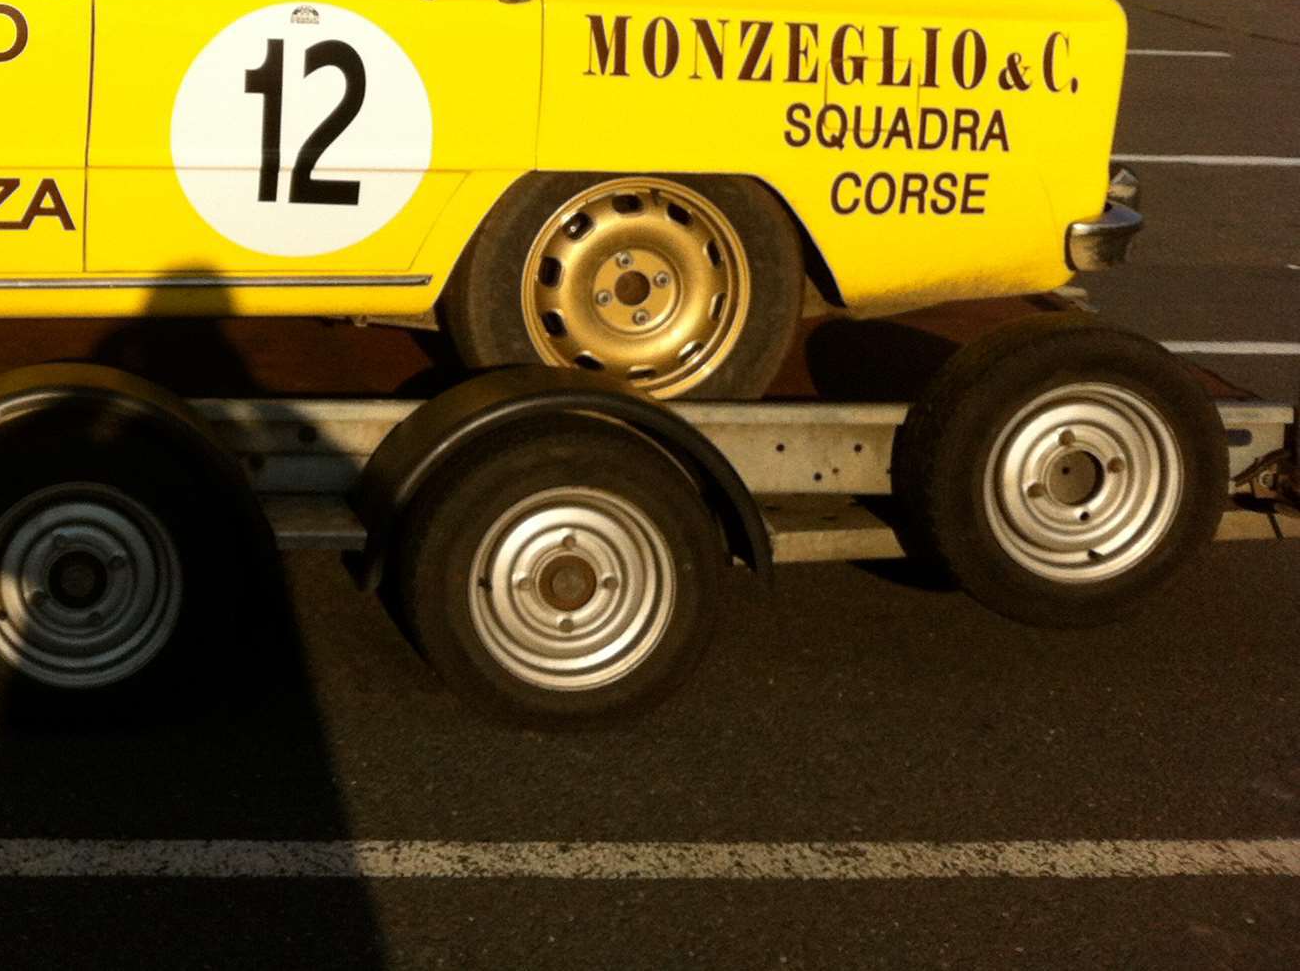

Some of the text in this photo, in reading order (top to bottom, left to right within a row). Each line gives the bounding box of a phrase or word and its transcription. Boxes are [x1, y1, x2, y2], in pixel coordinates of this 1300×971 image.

[244, 38, 367, 206] 12
[783, 102, 1010, 152] SQUADRA
[830, 171, 990, 215] CORSE
